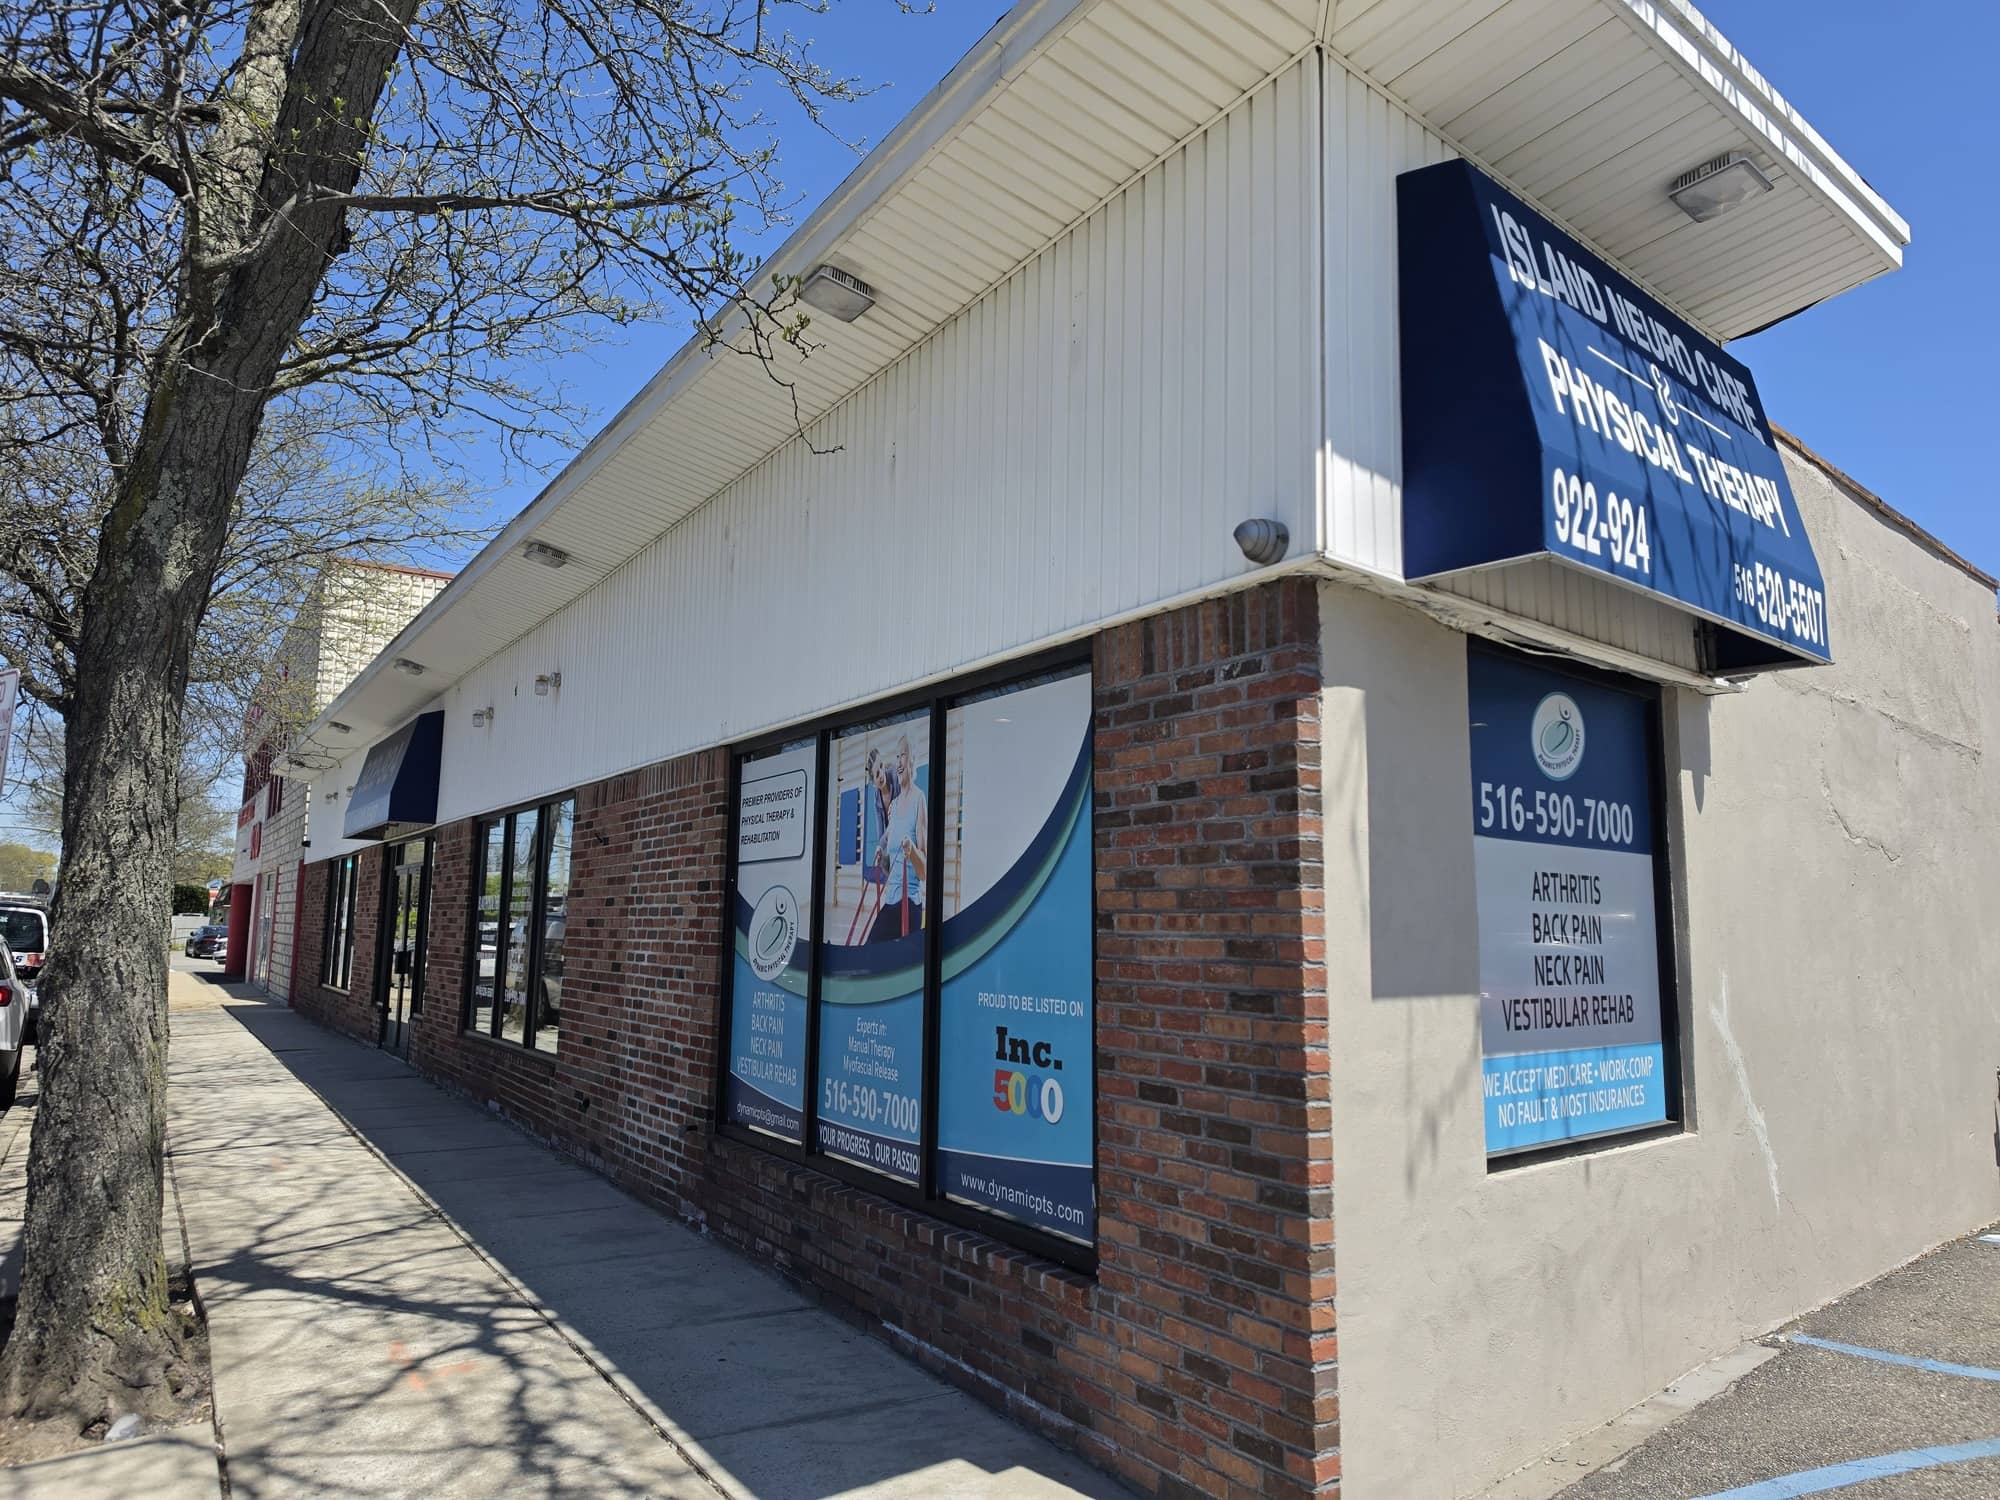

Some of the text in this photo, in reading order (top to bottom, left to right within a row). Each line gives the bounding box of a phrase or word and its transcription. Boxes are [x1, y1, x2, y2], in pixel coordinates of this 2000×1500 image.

[1490, 203, 1766, 445] ISLAND NEURO CARE
[1650, 363, 1679, 426] &
[1538, 337, 1790, 538] PHYSICAL THERAPY
[1553, 468, 1650, 574] 922-924
[1734, 562, 1825, 646] 516 520-5507
[742, 786, 803, 808] PREMIER PROVIDERS OF
[1481, 782, 1633, 844] 516-590-7000
[741, 814, 765, 826] PHYSICAL
[766, 808, 790, 822] THERAPY
[741, 829, 780, 845] REHABILITATION
[1532, 872, 1602, 905] ARTHRITIS
[1532, 912, 1602, 944] BACK PAIN
[1534, 955, 1605, 986] NECK PAIN
[752, 992, 785, 1012] ARTHRITIS
[978, 992, 1083, 1017] PROUD TO BE LISTED ON
[1502, 995, 1634, 1032] VESTIBULAR REHAB
[751, 1014, 784, 1035] BACK PAIN
[856, 1017, 878, 1037] Experts
[750, 1037, 783, 1061] NECK PAIN
[848, 1036, 895, 1063] Manual Therapy
[995, 1026, 1063, 1070] Inc.
[736, 1056, 797, 1087] VESTIBULAR REHAB
[843, 1055, 898, 1081] Myofascial Release
[1483, 1055, 1653, 1099] WE ACCEPT MEDICARE WORK-COMP
[824, 1077, 919, 1134] 516-590-7000
[993, 1068, 1063, 1124] 5000
[1499, 1085, 1645, 1129] NO FAULT & MOST INSURANCES
[736, 1101, 800, 1131] dynamicpts@gmail.com
[818, 1124, 837, 1146] YOUR
[836, 1131, 871, 1160] PROGRESS
[874, 1141, 891, 1167] OUR
[891, 1147, 921, 1176] PASSIO
[961, 1172, 1085, 1226] www.dynamicpts.com
